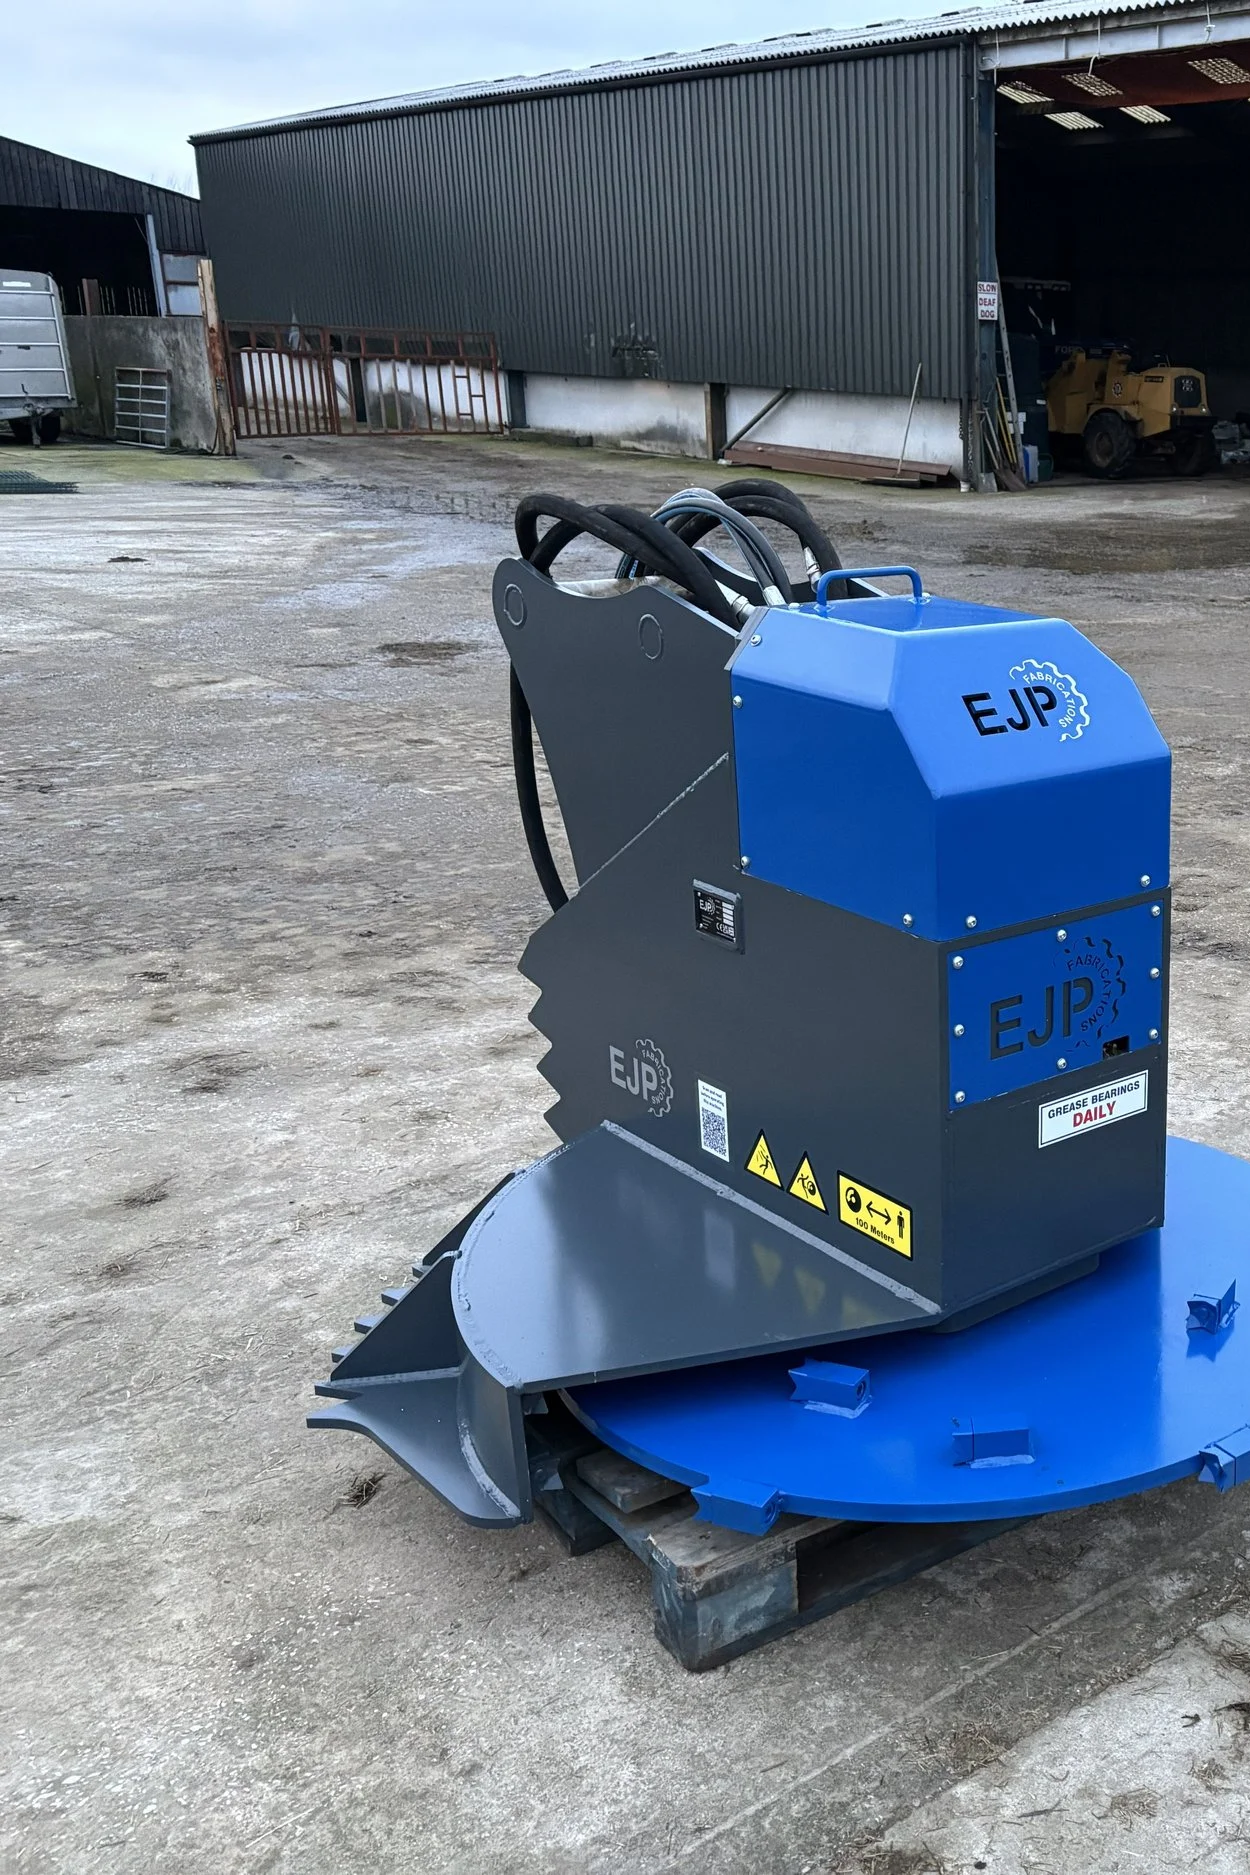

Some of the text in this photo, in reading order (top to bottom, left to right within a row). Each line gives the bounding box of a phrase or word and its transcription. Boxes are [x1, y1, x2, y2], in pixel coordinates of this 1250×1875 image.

[978, 283, 997, 293] SLOW
[979, 297, 996, 306] DEAF
[980, 310, 995, 319] DOG
[961, 685, 1057, 737] EJP
[1023, 671, 1076, 728] FABRICATIONS
[1067, 954, 1113, 1032] FABRICATIONS
[990, 976, 1094, 1060] EJP
[609, 1045, 658, 1101] EJP
[642, 1049, 667, 1104] FABRICATIONS
[1048, 1081, 1140, 1119] GREASE BEARINGS
[1073, 1101, 1116, 1127] DAILY
[856, 1217, 895, 1245] 100 Meters
